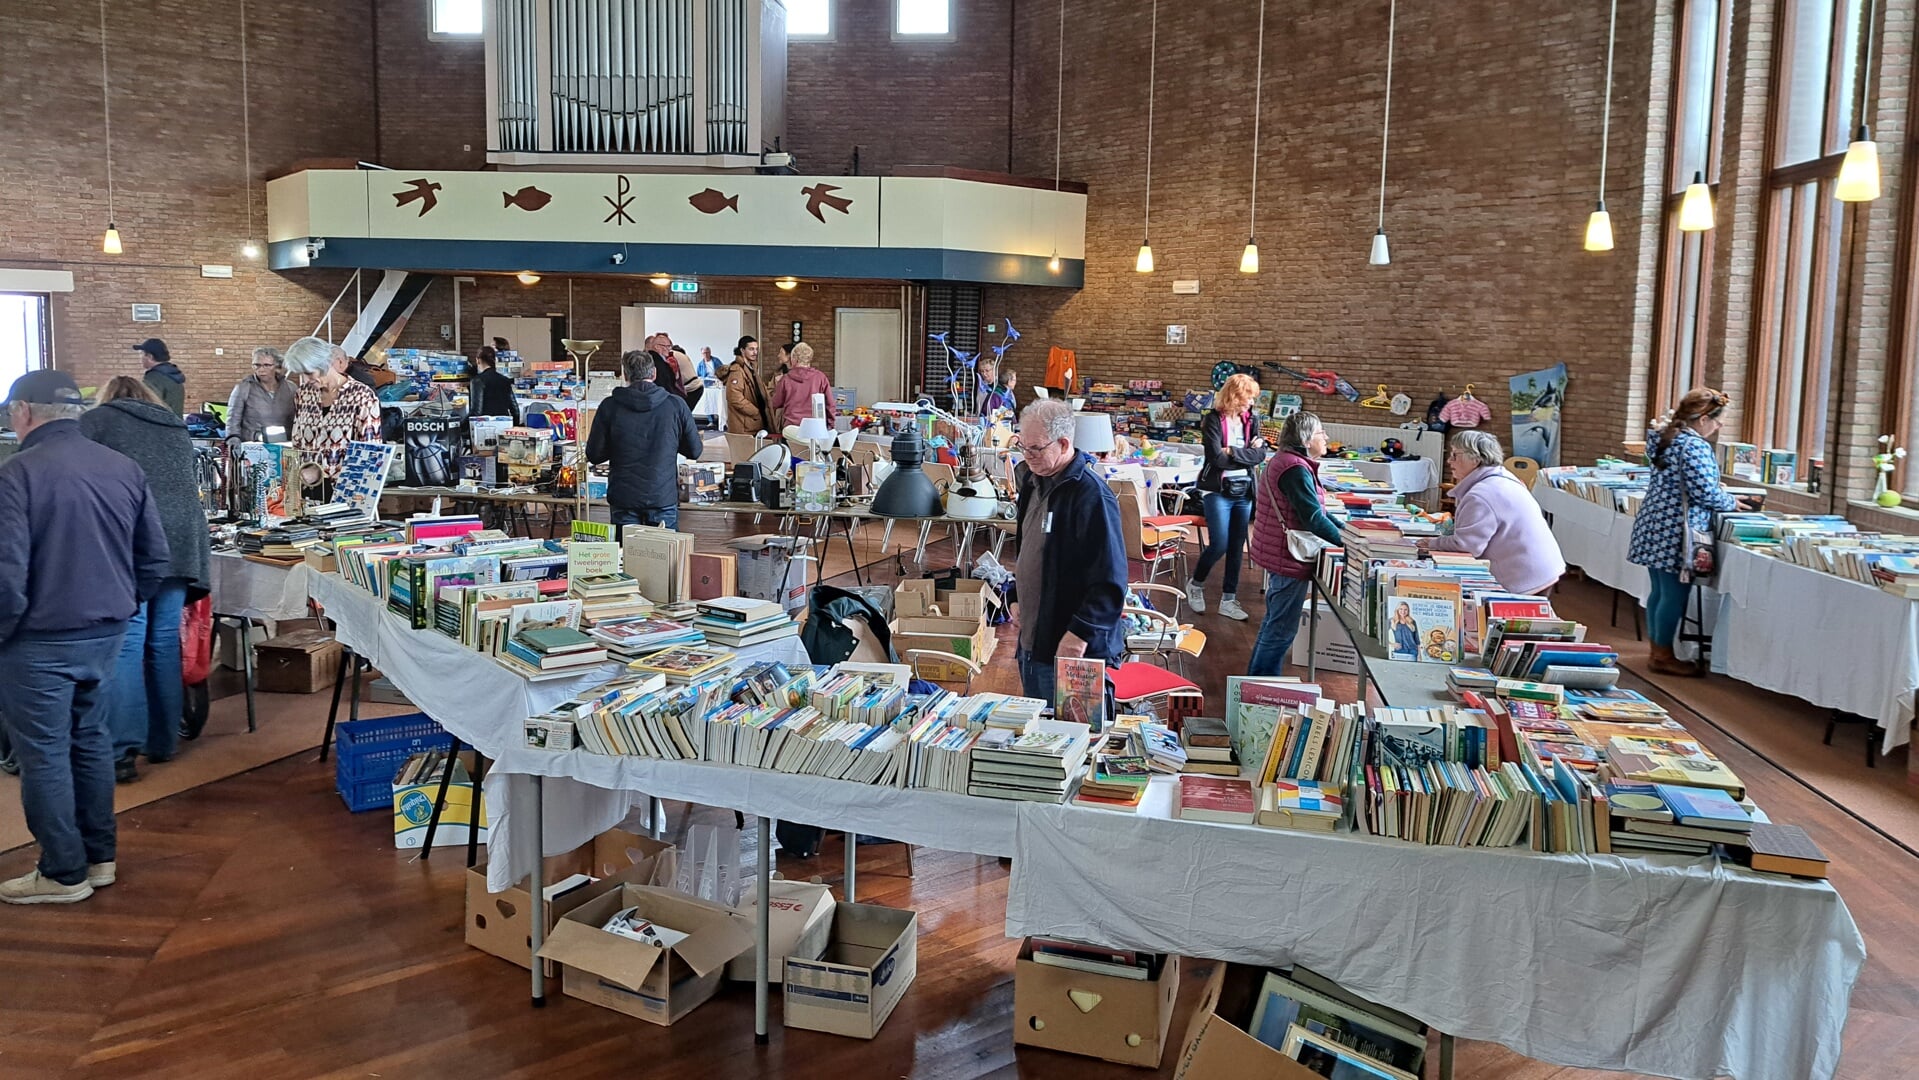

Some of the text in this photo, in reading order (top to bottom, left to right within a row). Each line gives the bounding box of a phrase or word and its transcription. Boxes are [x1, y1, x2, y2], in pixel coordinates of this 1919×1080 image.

[407, 422, 445, 432] BOSCH
[592, 551, 611, 560] grote
[574, 559, 614, 568] tweelingen-
[1312, 714, 1325, 745] BIJBELS
